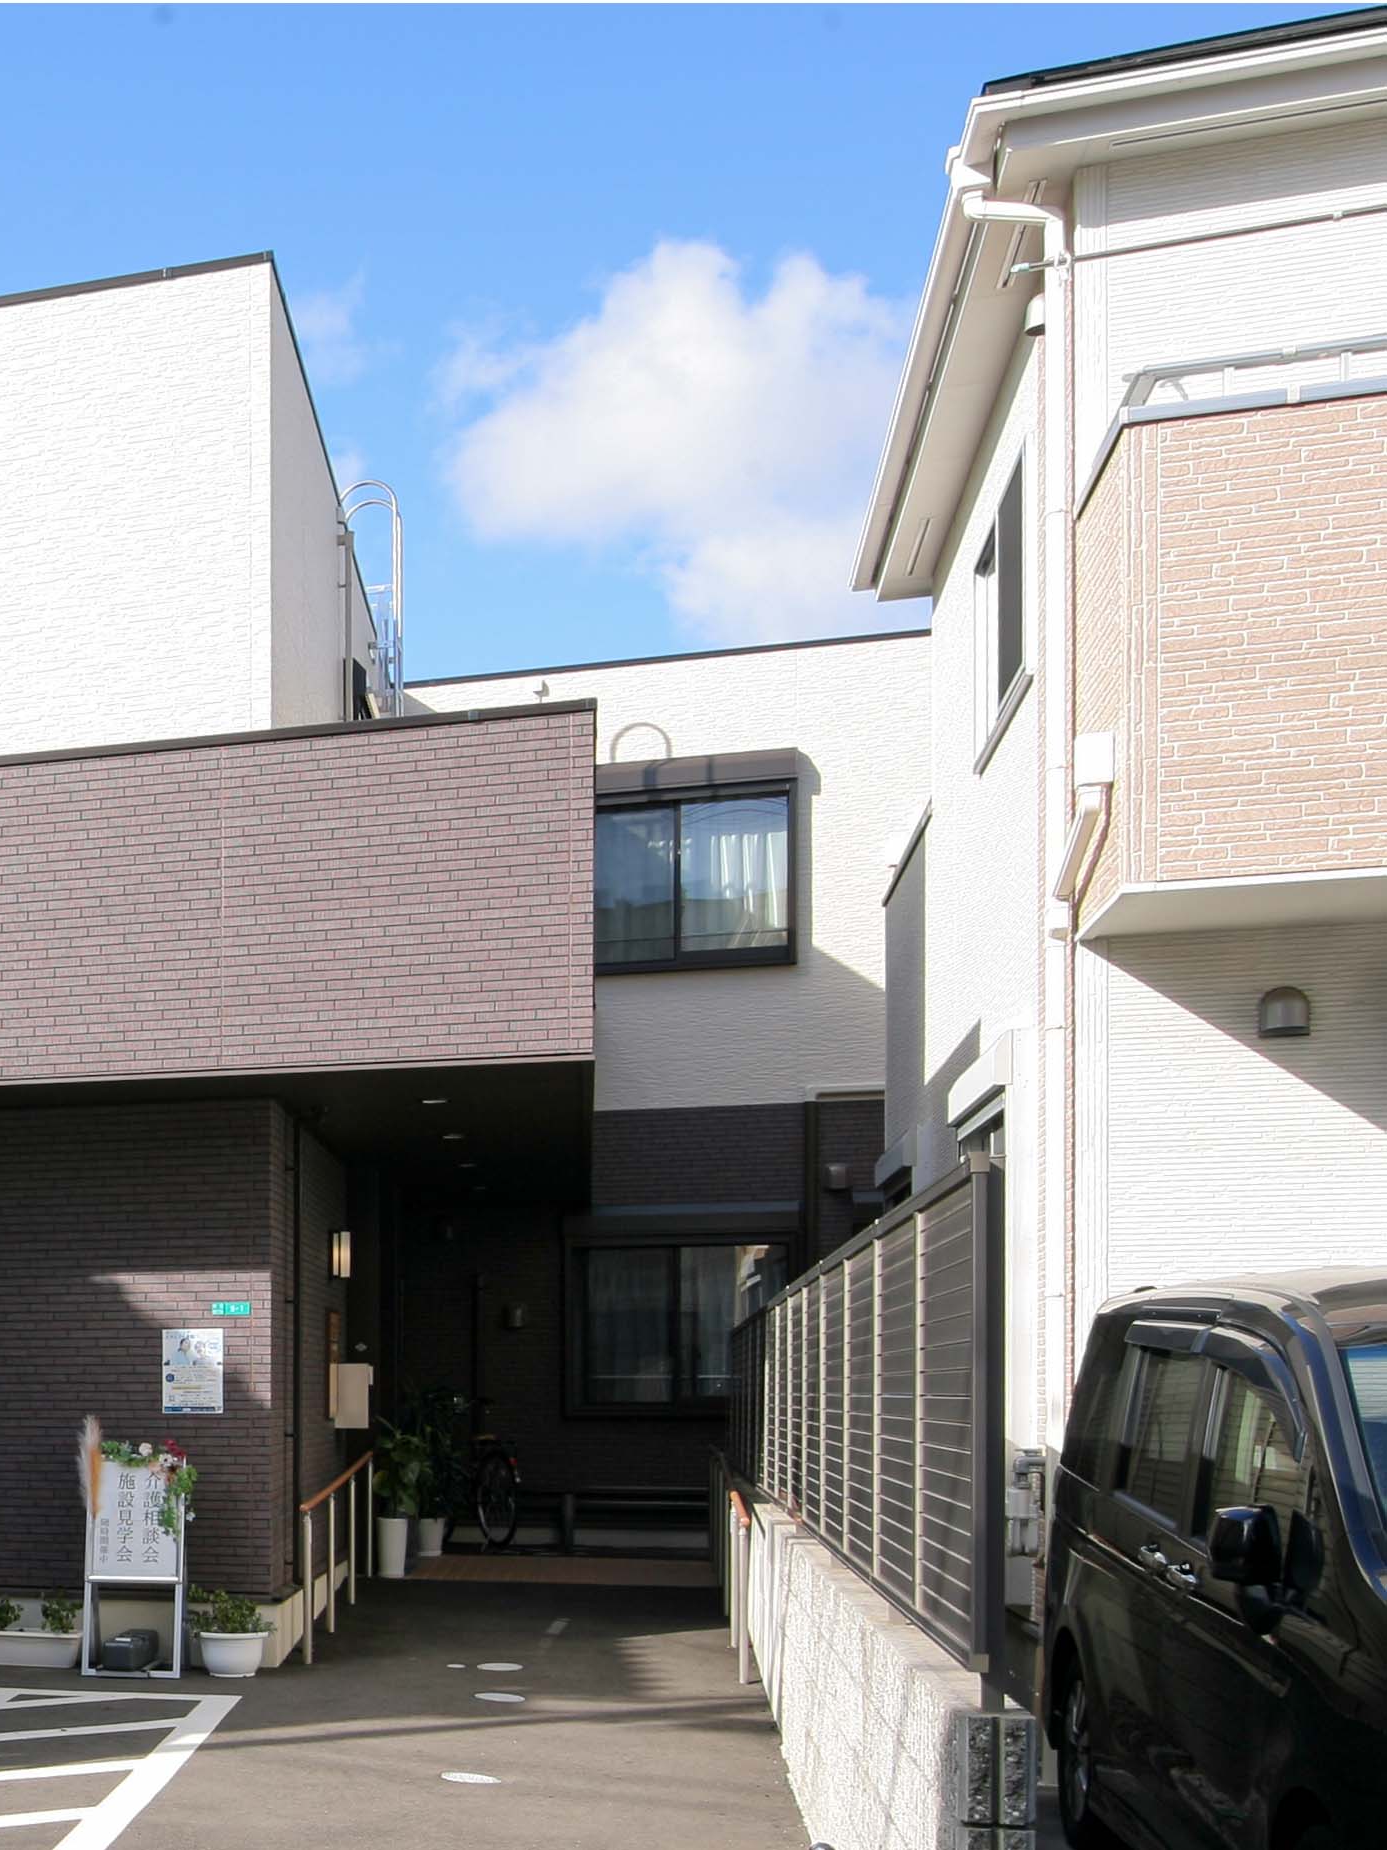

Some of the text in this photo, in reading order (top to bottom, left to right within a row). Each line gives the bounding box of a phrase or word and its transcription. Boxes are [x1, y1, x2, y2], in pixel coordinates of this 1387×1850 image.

[117, 1472, 136, 1562] 施設見学会
[143, 1472, 164, 1563] 介護相談会
